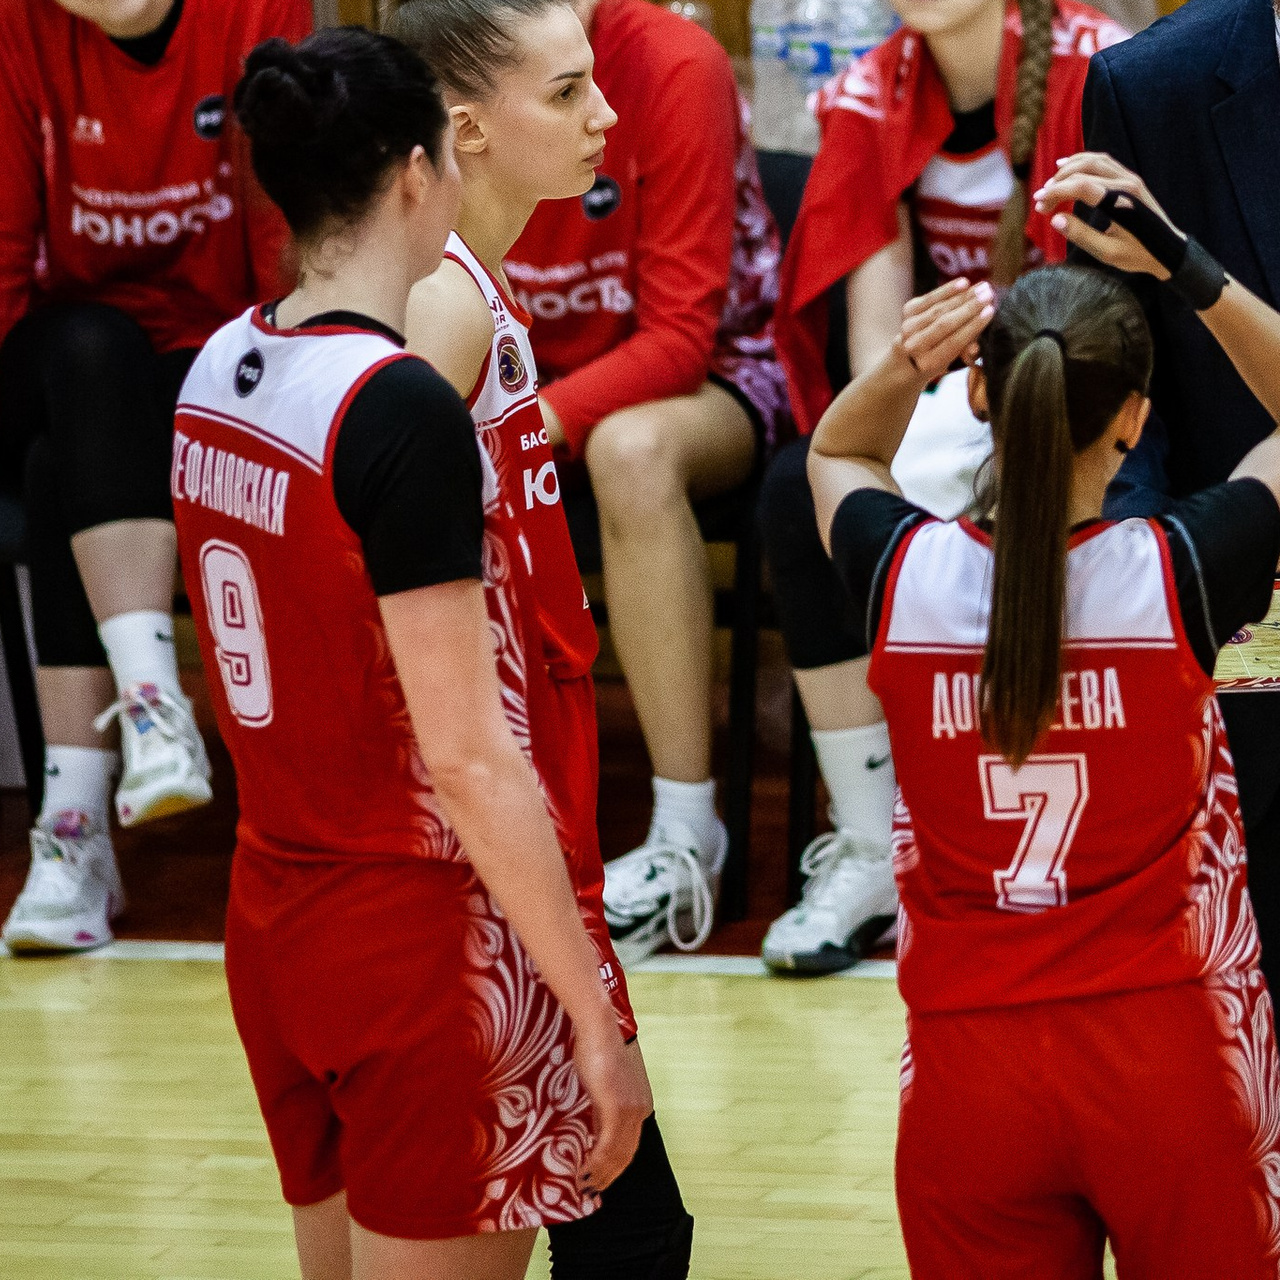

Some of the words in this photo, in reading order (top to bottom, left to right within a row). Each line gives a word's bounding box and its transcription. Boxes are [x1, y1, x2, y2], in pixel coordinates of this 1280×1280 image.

[71, 194, 233, 247] ЮНОСЬ
[199, 538, 273, 729] 9
[932, 667, 1126, 739] ДОЕВА
[977, 753, 1090, 914] 7
